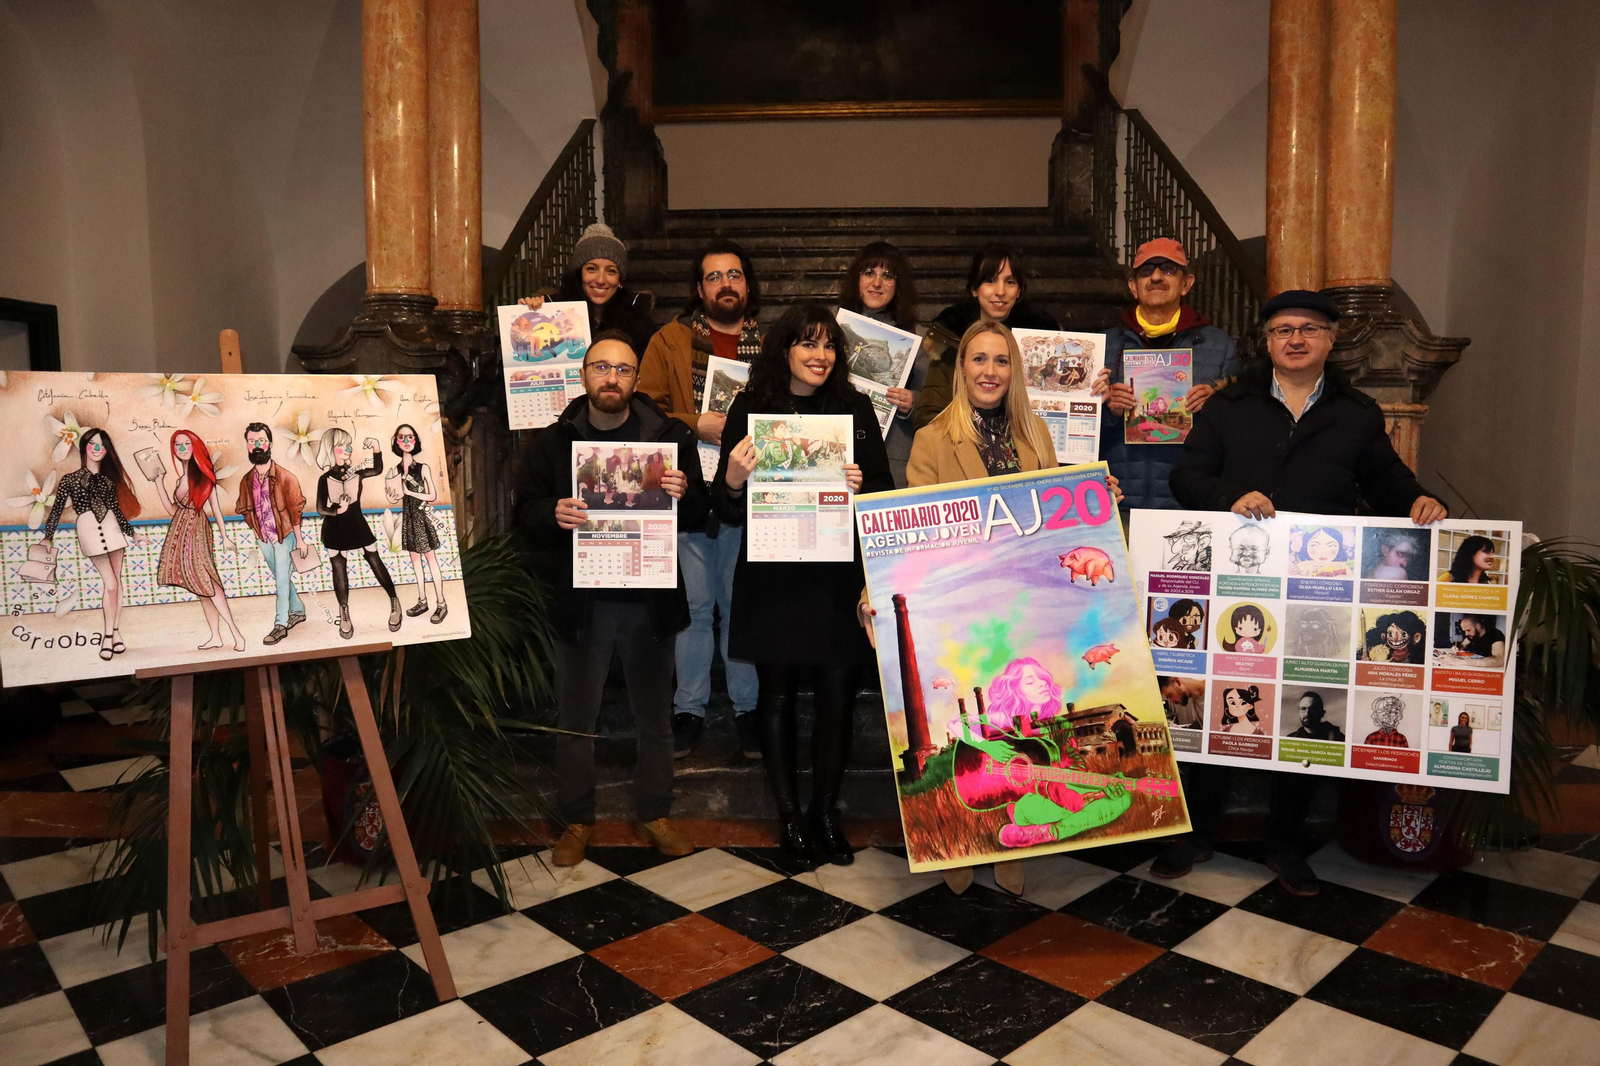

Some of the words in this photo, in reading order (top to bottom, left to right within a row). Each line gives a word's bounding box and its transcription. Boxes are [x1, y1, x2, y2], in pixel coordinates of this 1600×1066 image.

[861, 504, 940, 534] CALENDARIO
[944, 499, 979, 522] 2020
[866, 532, 929, 550] AGENDA
[932, 523, 981, 540] JOVEN
[866, 548, 893, 557] REVISTA
[951, 538, 980, 546] JUVENIL
